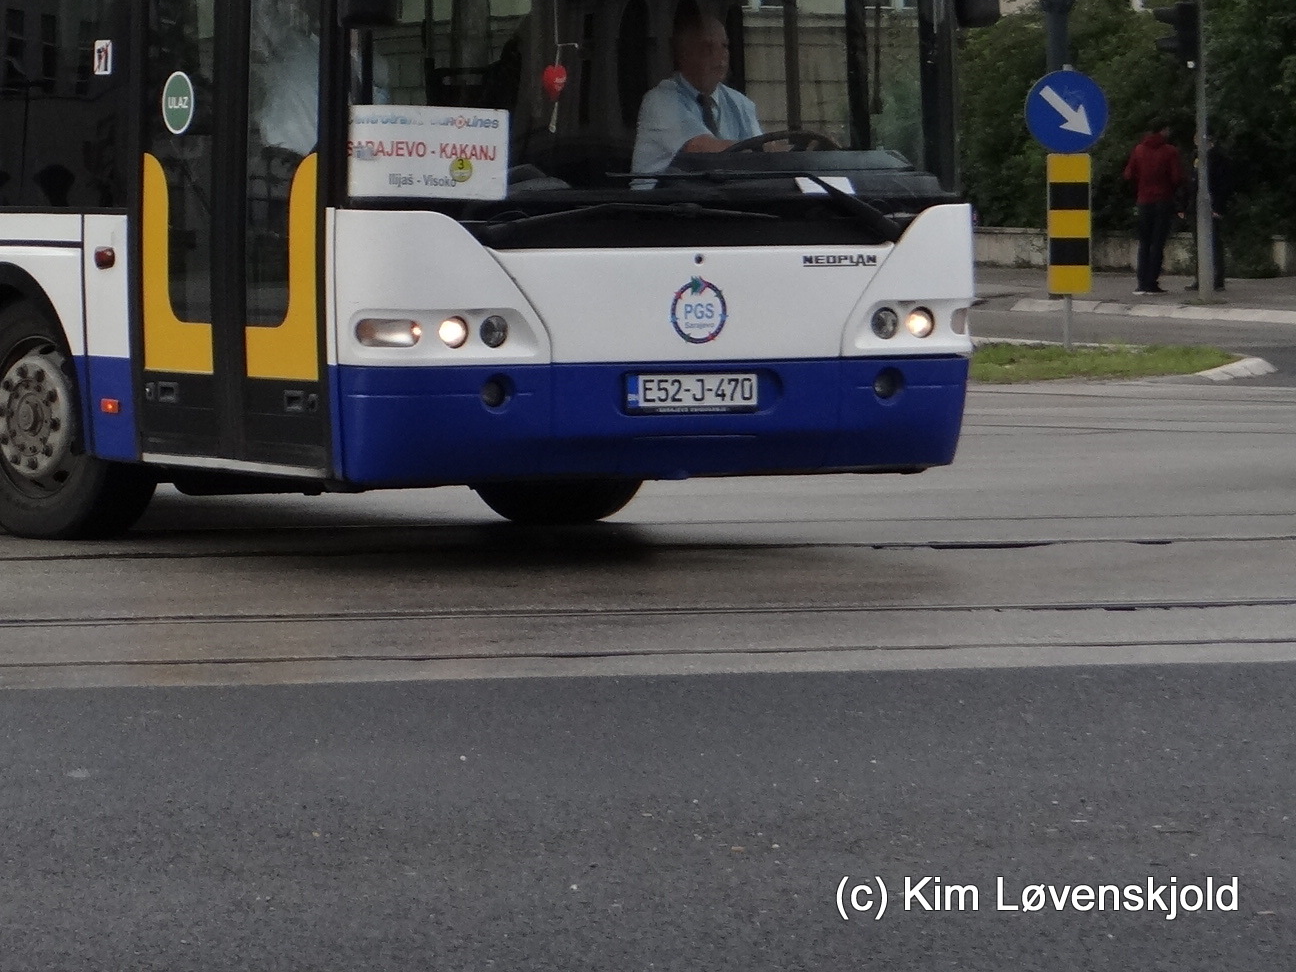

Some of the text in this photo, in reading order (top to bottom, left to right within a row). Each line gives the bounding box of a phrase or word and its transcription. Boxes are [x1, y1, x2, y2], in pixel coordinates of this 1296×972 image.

[167, 96, 189, 109] ULAZ
[439, 142, 497, 161] KAKANJ
[457, 158, 465, 170] 3
[803, 254, 877, 266] NEOPLAN
[684, 303, 714, 319] PGS
[642, 377, 754, 403] E52-J-470
